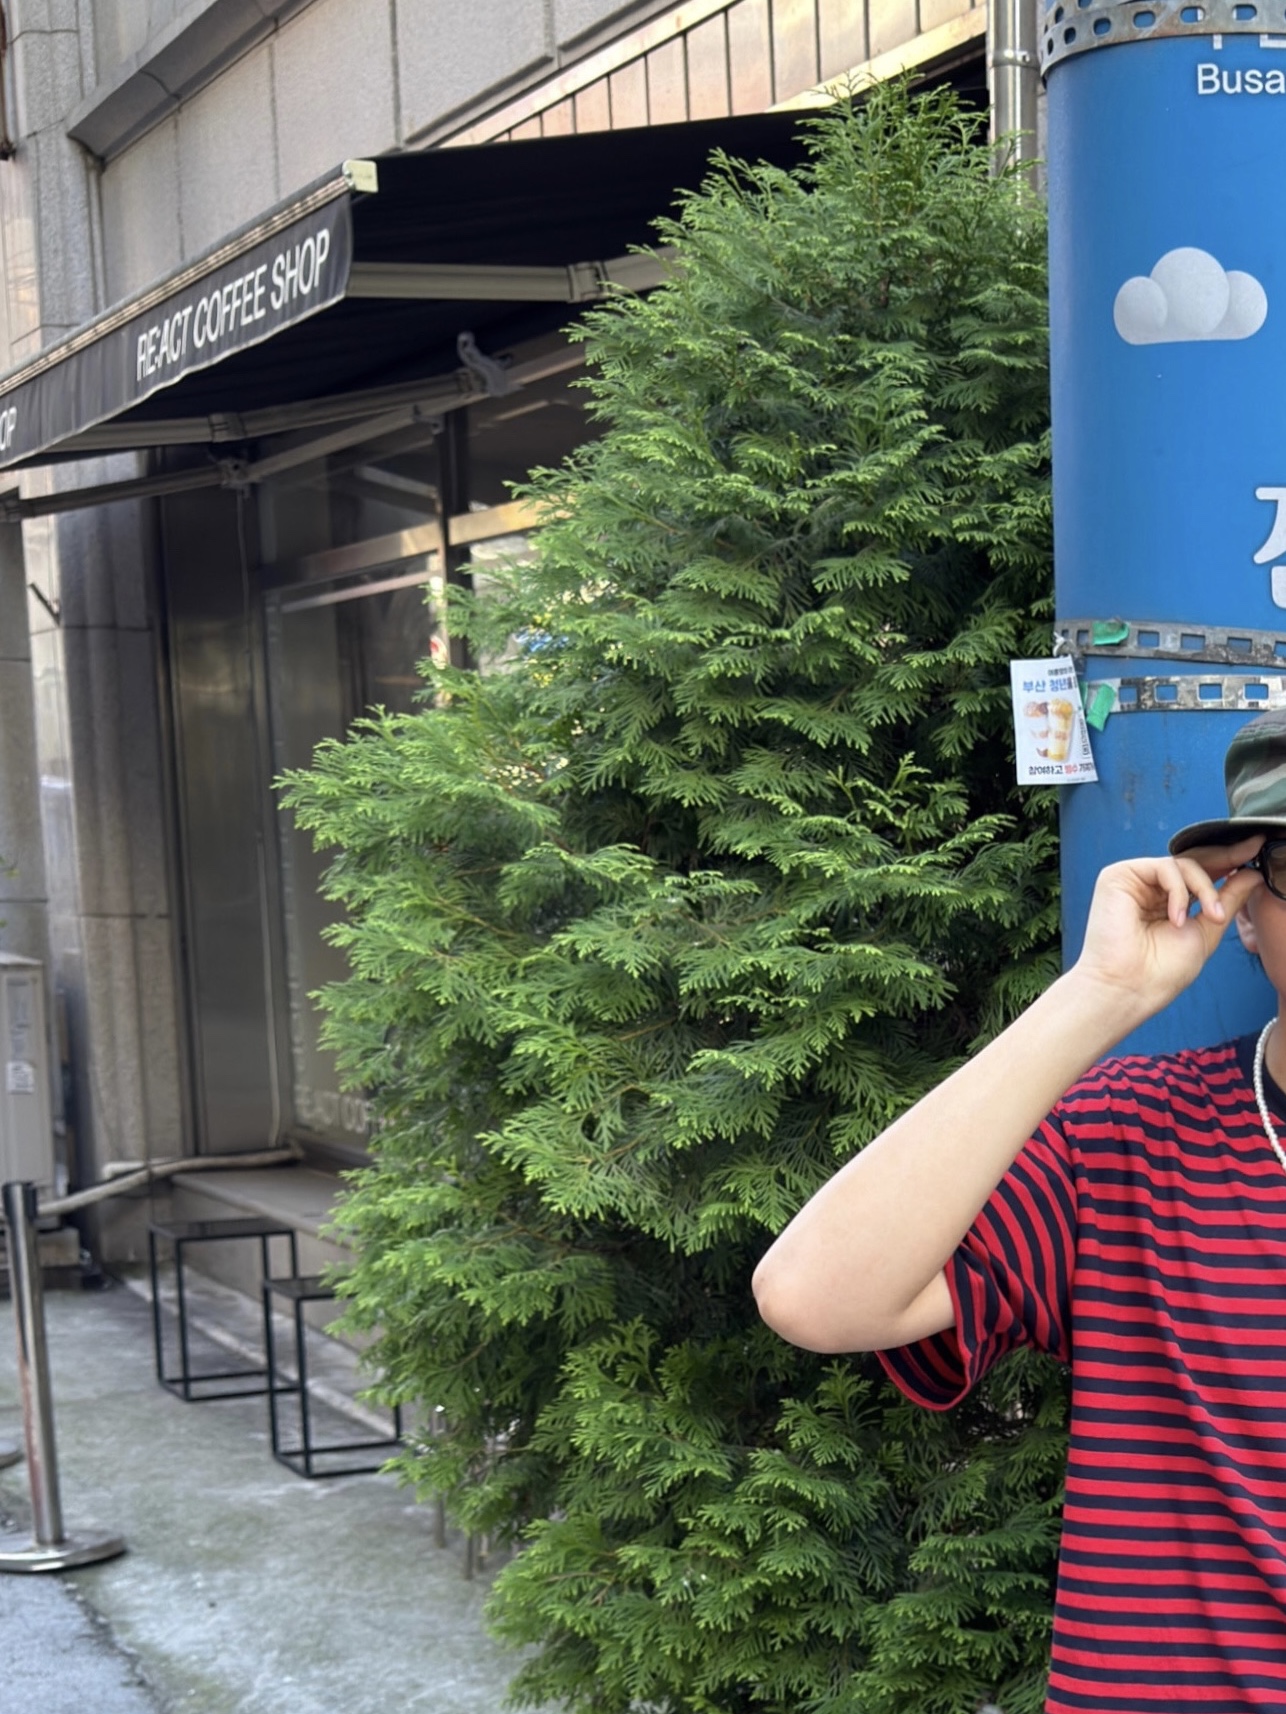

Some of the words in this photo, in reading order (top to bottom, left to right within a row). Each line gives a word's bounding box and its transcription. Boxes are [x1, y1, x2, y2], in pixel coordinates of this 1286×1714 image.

[193, 263, 268, 349] COFFEE
[270, 227, 330, 311] SHOP
[1023, 679, 1046, 693] 부산
